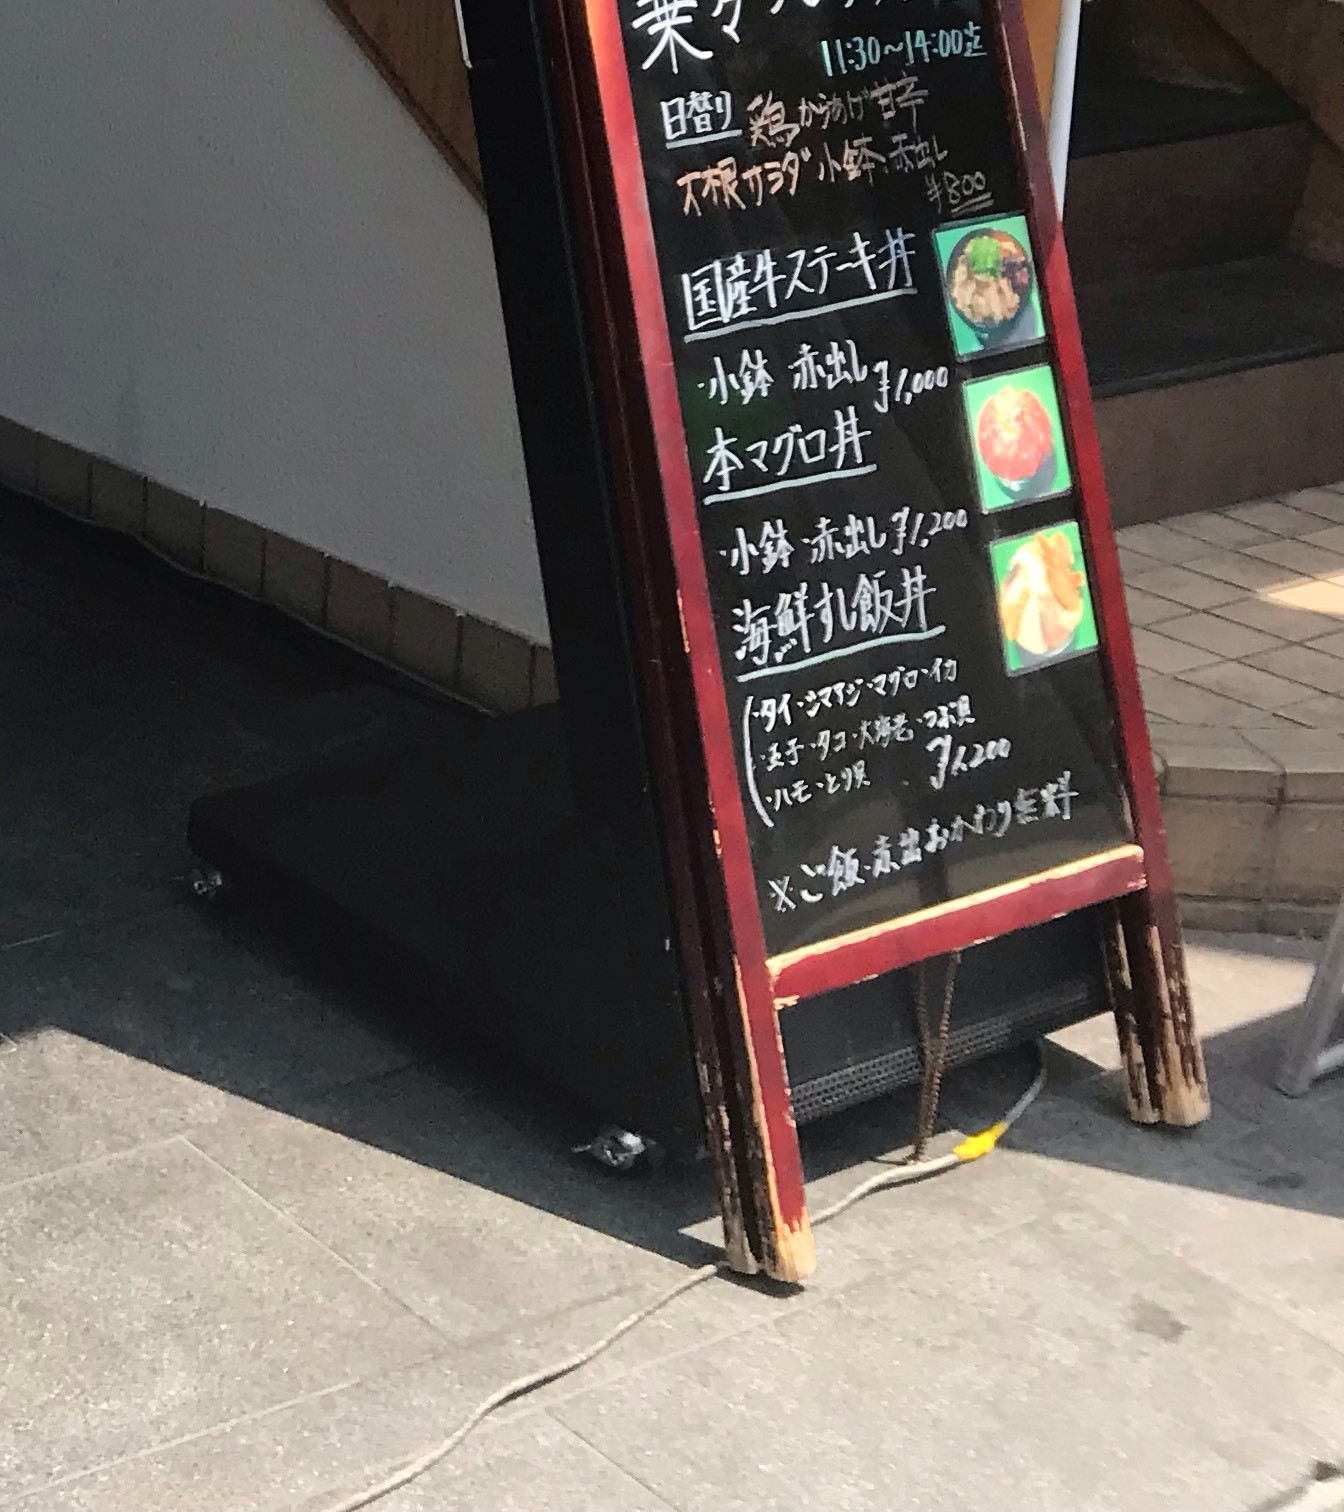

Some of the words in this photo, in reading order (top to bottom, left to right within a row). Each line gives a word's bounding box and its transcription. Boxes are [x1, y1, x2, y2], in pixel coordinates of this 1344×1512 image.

[681, 227, 916, 331] 国産牛ステーキ丼
[703, 405, 872, 491] 本マグロ丼
